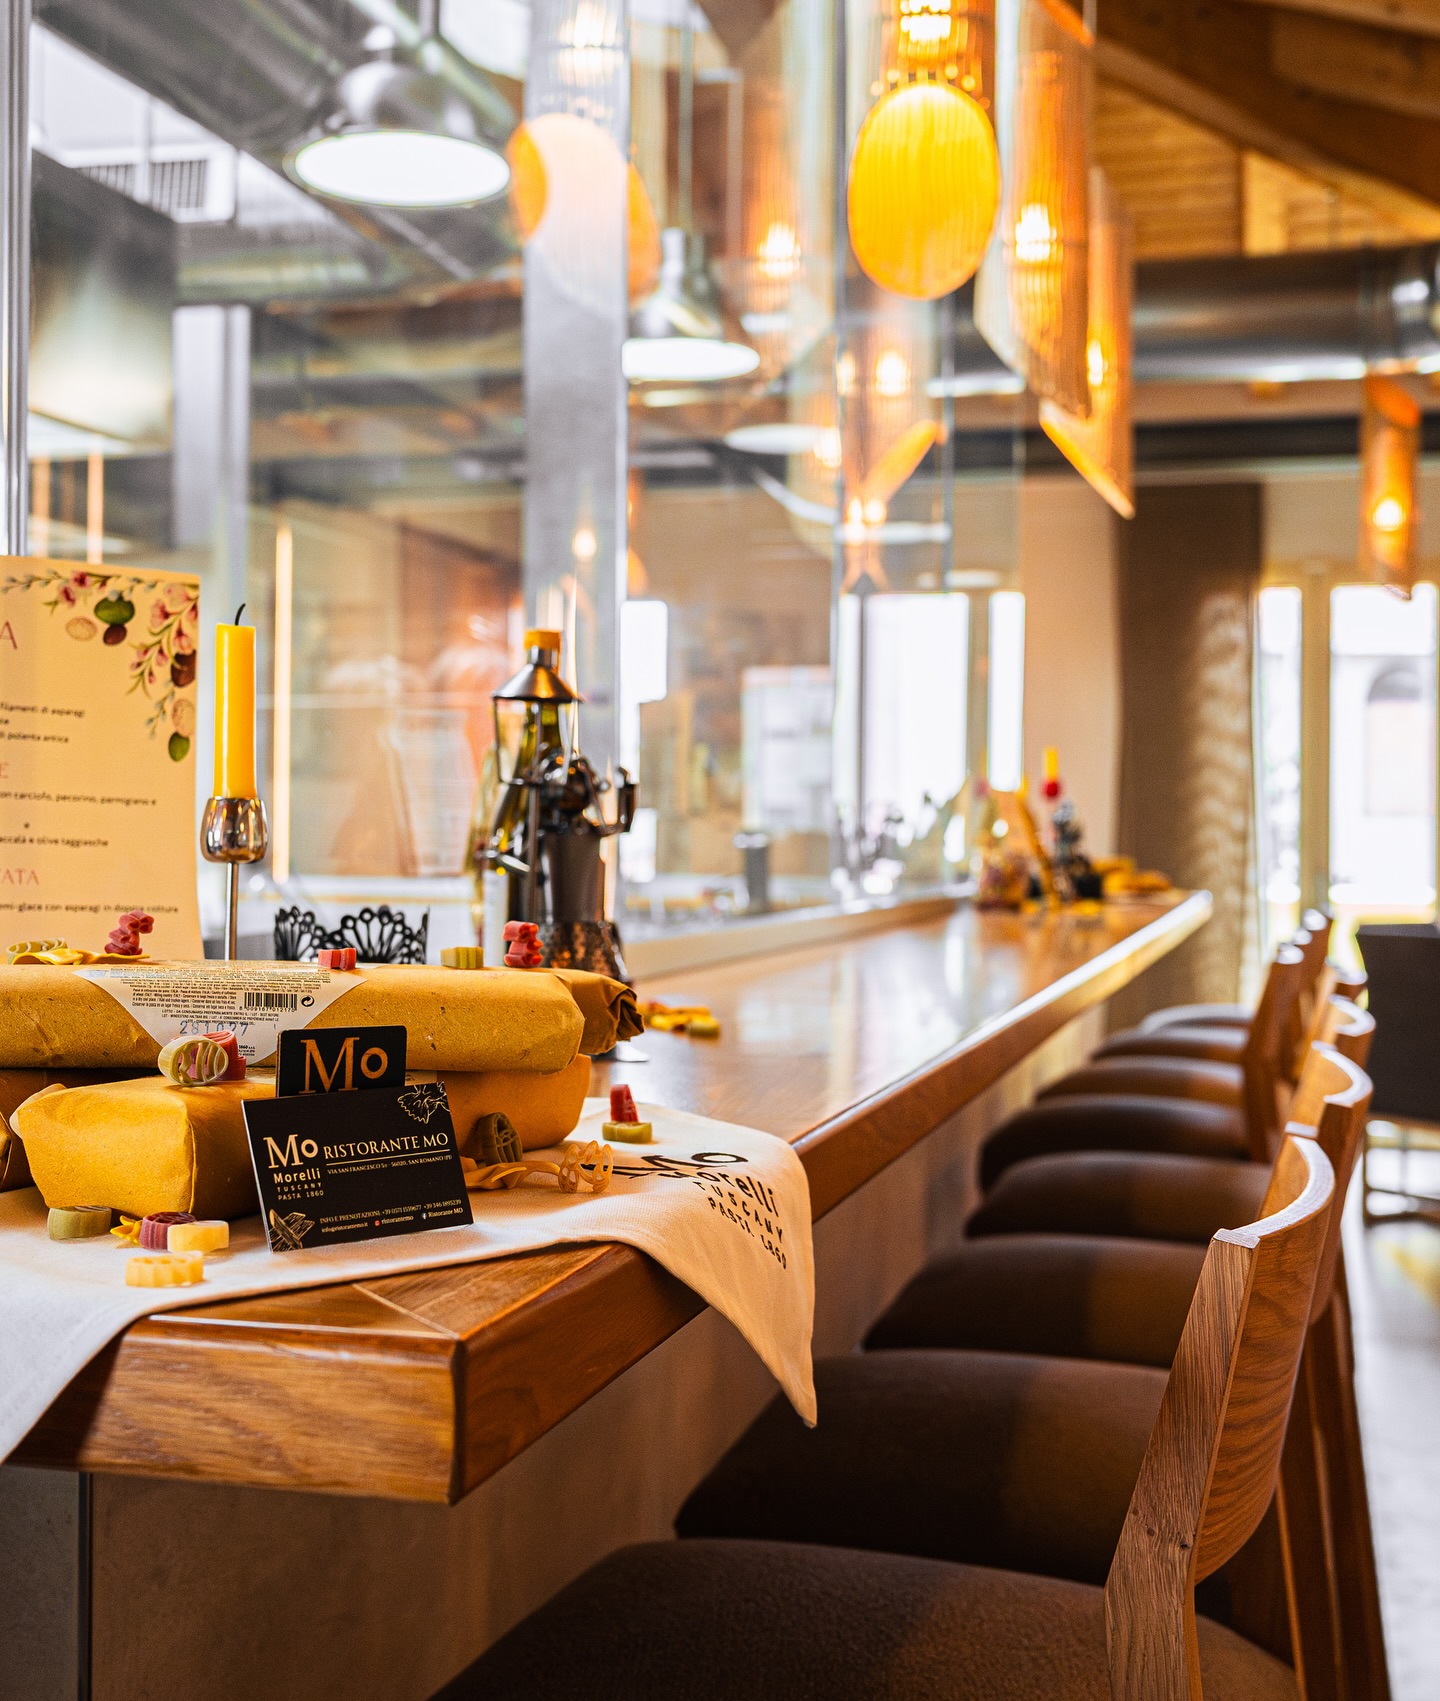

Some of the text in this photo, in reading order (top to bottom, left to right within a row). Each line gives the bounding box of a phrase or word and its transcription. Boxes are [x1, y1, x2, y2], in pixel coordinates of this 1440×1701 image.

[299, 1037, 388, 1094] Mo
[263, 1134, 319, 1169] Mo
[323, 1132, 449, 1160] RISTORANTE MO
[349, 1163, 381, 1173] FRANCESCO
[419, 1155, 443, 1164] ROMANO
[273, 1168, 321, 1184] Morelli
[276, 1182, 322, 1193] TUSCANY
[277, 1190, 324, 1201] PASTA 1860
[319, 1216, 334, 1224] INFO
[692, 1181, 784, 1244] TUSCANY
[707, 1196, 755, 1237] PASTA
